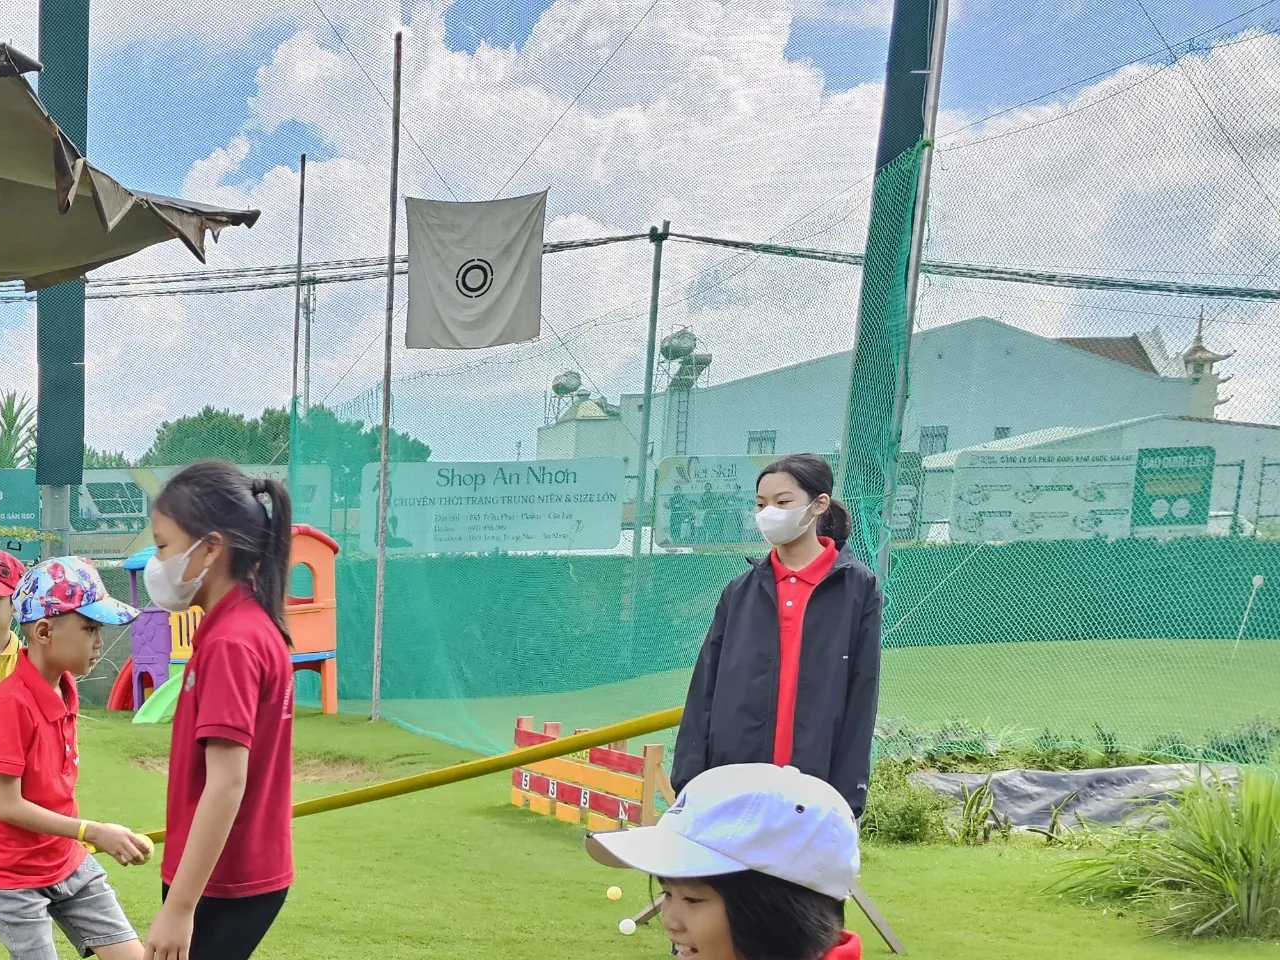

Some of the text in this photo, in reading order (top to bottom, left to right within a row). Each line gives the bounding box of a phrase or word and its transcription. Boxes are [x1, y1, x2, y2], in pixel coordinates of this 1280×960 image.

[436, 466, 577, 491] Shop An Nhơn
[393, 495, 435, 507] CHUYÊN
[438, 494, 463, 506] THỜI
[464, 494, 501, 506] TRANG
[501, 494, 536, 505] TRUNG
[537, 492, 563, 504] NIÊN
[564, 494, 572, 503] &
[573, 493, 595, 503] SIZE
[522, 774, 529, 789] 5
[549, 781, 557, 796] 3
[582, 791, 589, 806] 5
